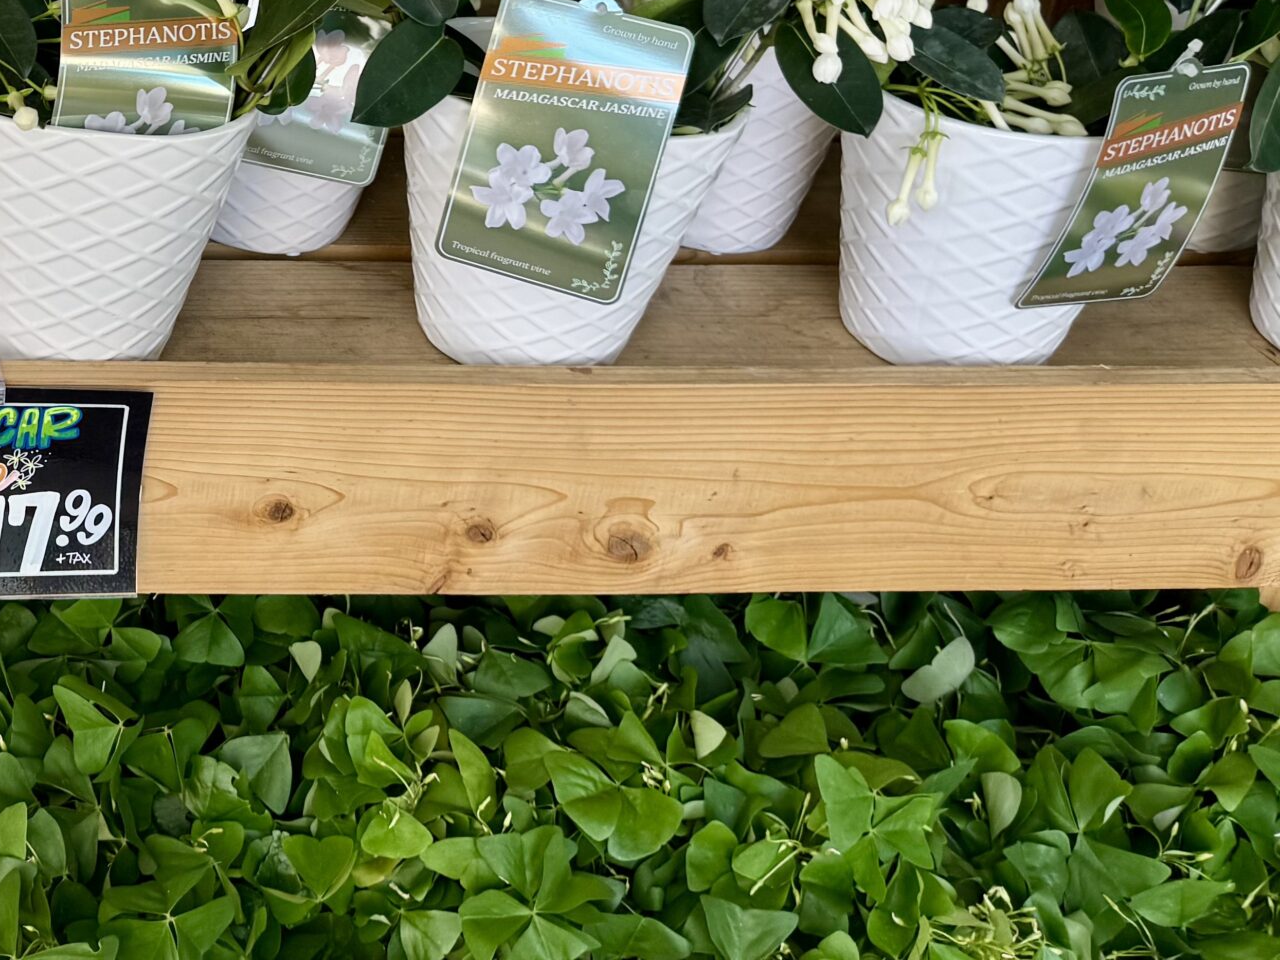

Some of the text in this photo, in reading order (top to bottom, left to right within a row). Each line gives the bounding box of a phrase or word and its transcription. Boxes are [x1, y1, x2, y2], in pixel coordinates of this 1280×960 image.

[70, 22, 231, 49] STEPHANOTIS
[602, 25, 678, 50] Grown by hand
[173, 51, 231, 65] JASMINE
[491, 58, 676, 97] STEPHANOTIS
[494, 89, 667, 119] MADAGASCAR JASMINE
[1103, 109, 1236, 161] STEPHANOTIS
[261, 147, 295, 160] fragrant
[1102, 136, 1229, 179] MADAGASCAR JASMINE
[452, 240, 551, 276] Tropical fragrant vine
